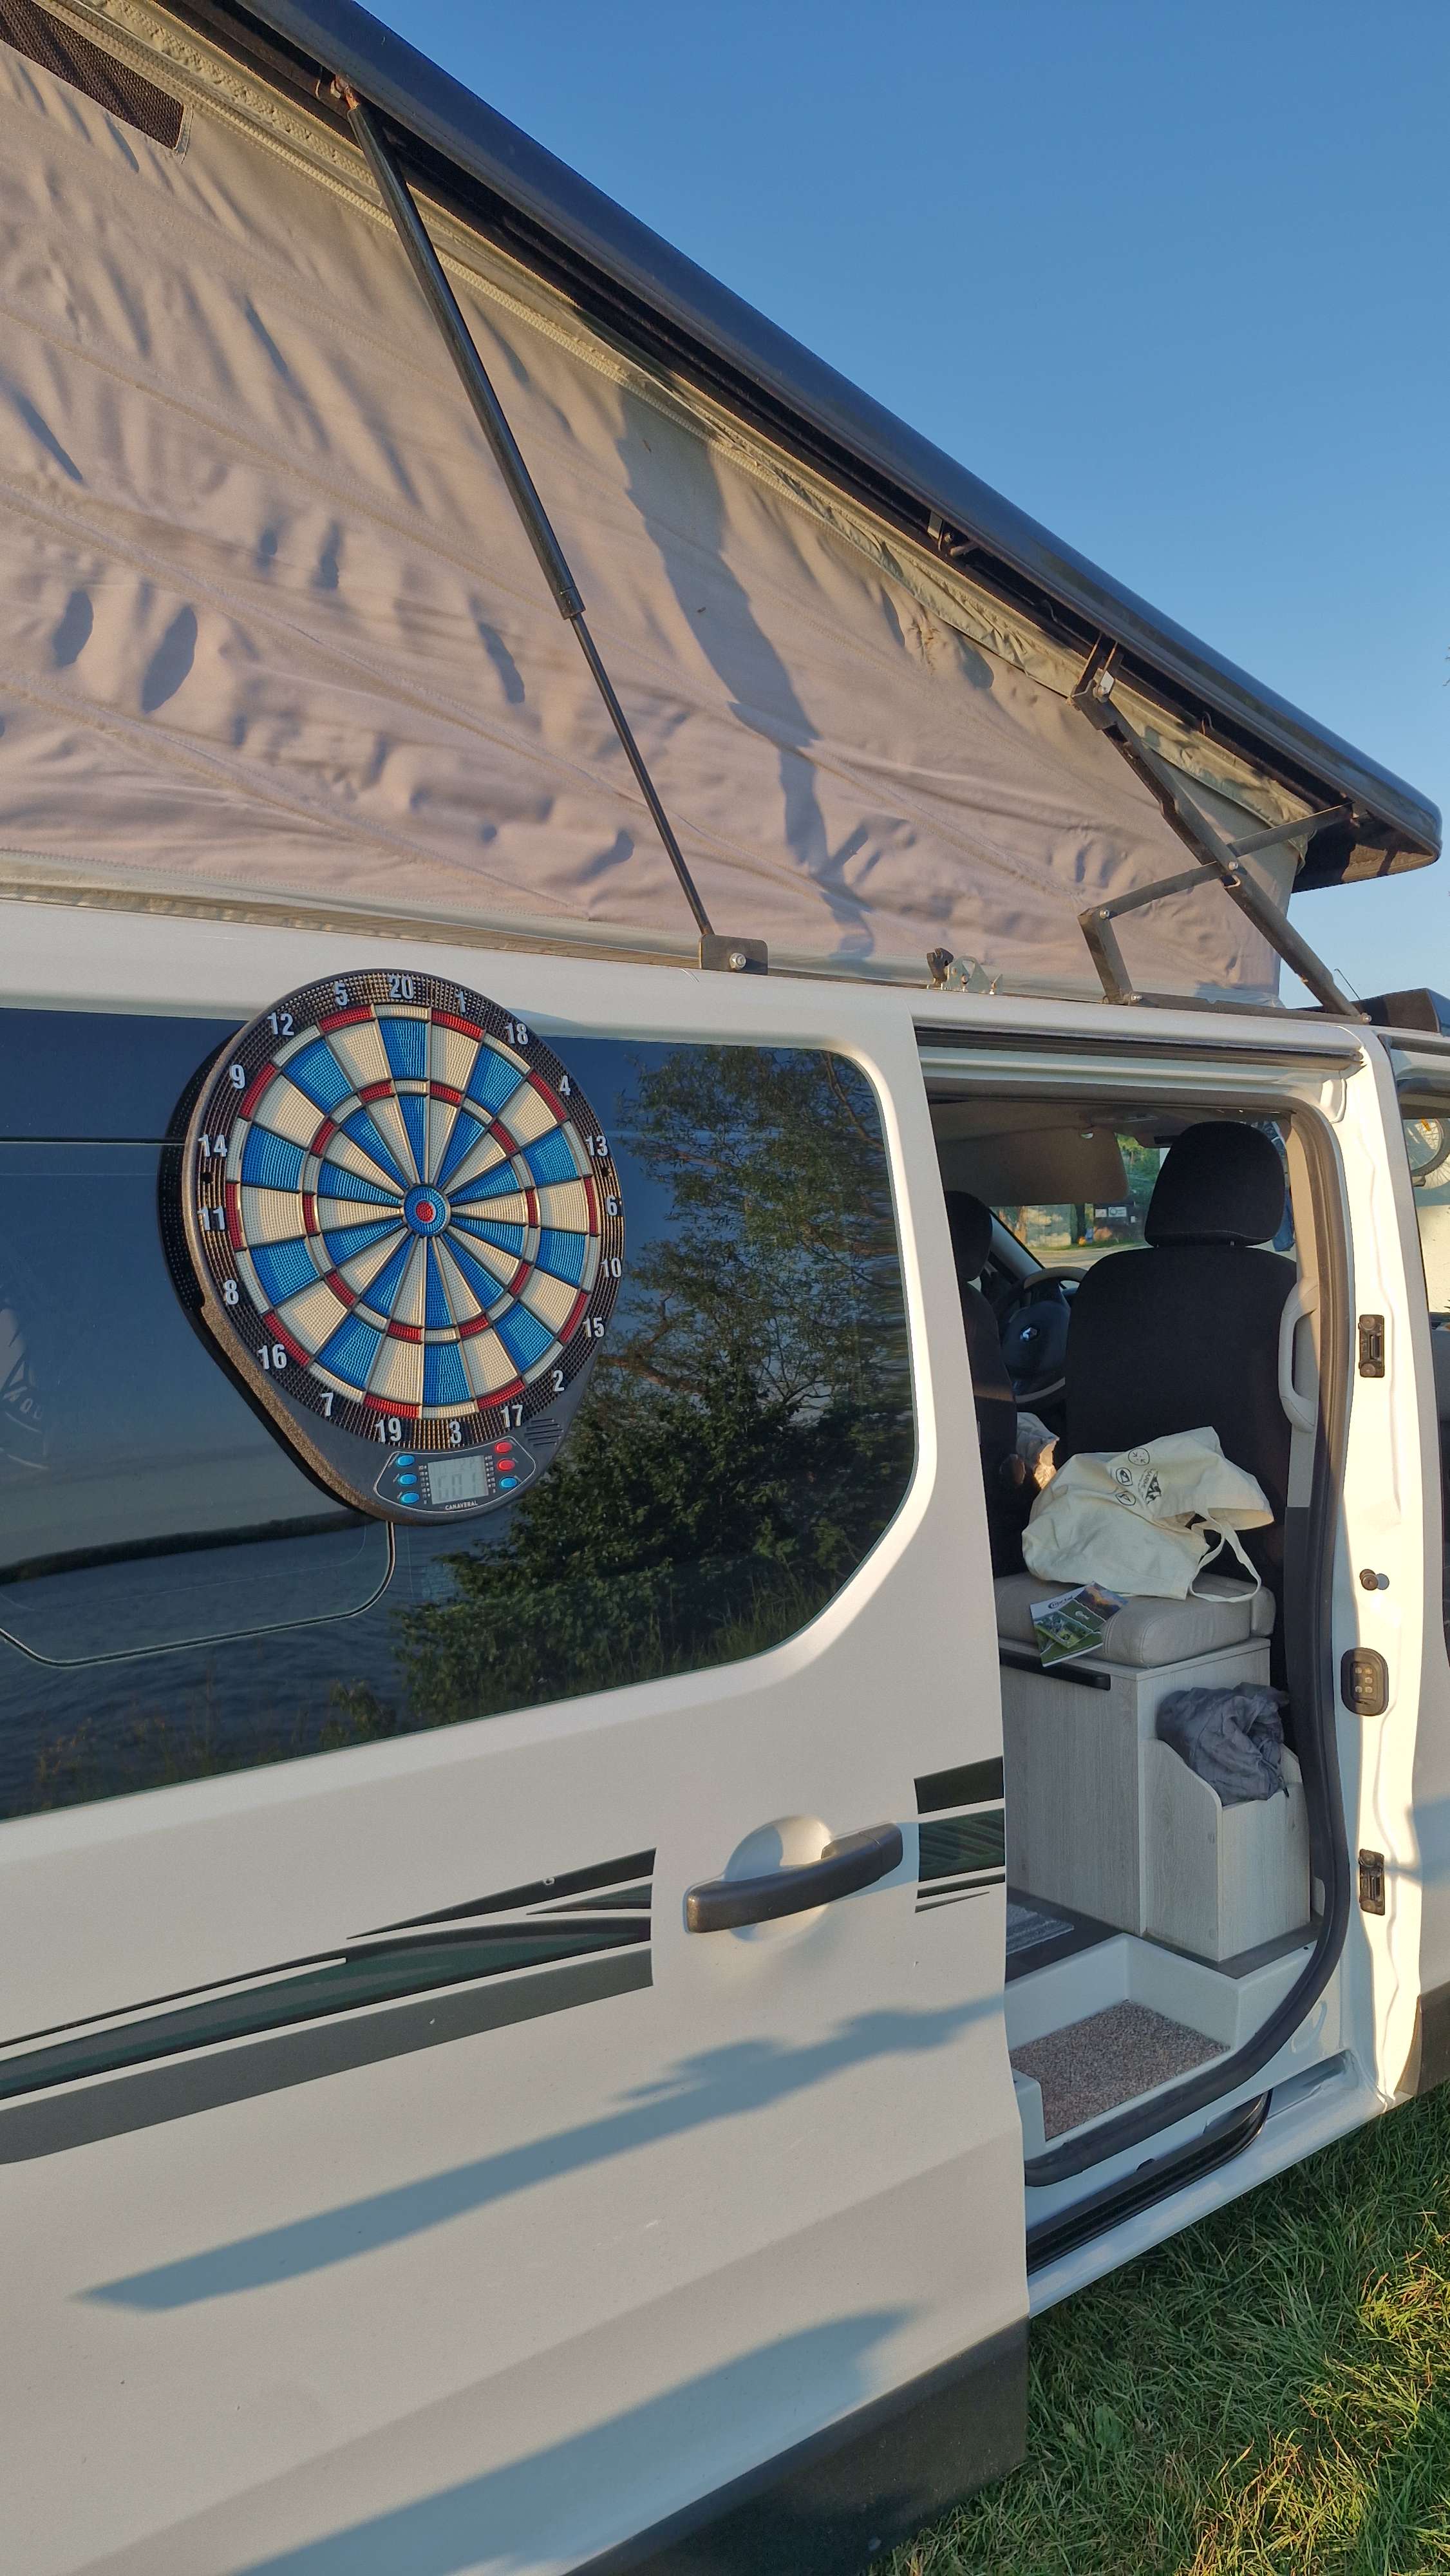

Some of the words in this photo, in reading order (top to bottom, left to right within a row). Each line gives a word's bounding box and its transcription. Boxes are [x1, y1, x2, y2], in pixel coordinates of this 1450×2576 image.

[334, 983, 348, 1005] 5
[388, 976, 414, 1000] 20
[457, 992, 466, 1013] 1
[267, 1014, 296, 1036] 12
[505, 1023, 529, 1045] 18
[230, 1065, 245, 1089] 9
[560, 1075, 570, 1095] 4
[199, 1135, 228, 1157] 14
[585, 1136, 608, 1155] 13
[605, 1196, 617, 1215] 6
[198, 1208, 226, 1230] 11
[601, 1258, 621, 1277] 10
[224, 1280, 239, 1305] 8
[583, 1317, 604, 1338] 15
[258, 1344, 287, 1369] 16
[552, 1370, 565, 1392] 2
[321, 1392, 334, 1416] 7
[501, 1405, 523, 1426] 17
[375, 1418, 401, 1443] 19
[450, 1421, 462, 1444] 3
[445, 1501, 478, 1511] CANAVERAL
